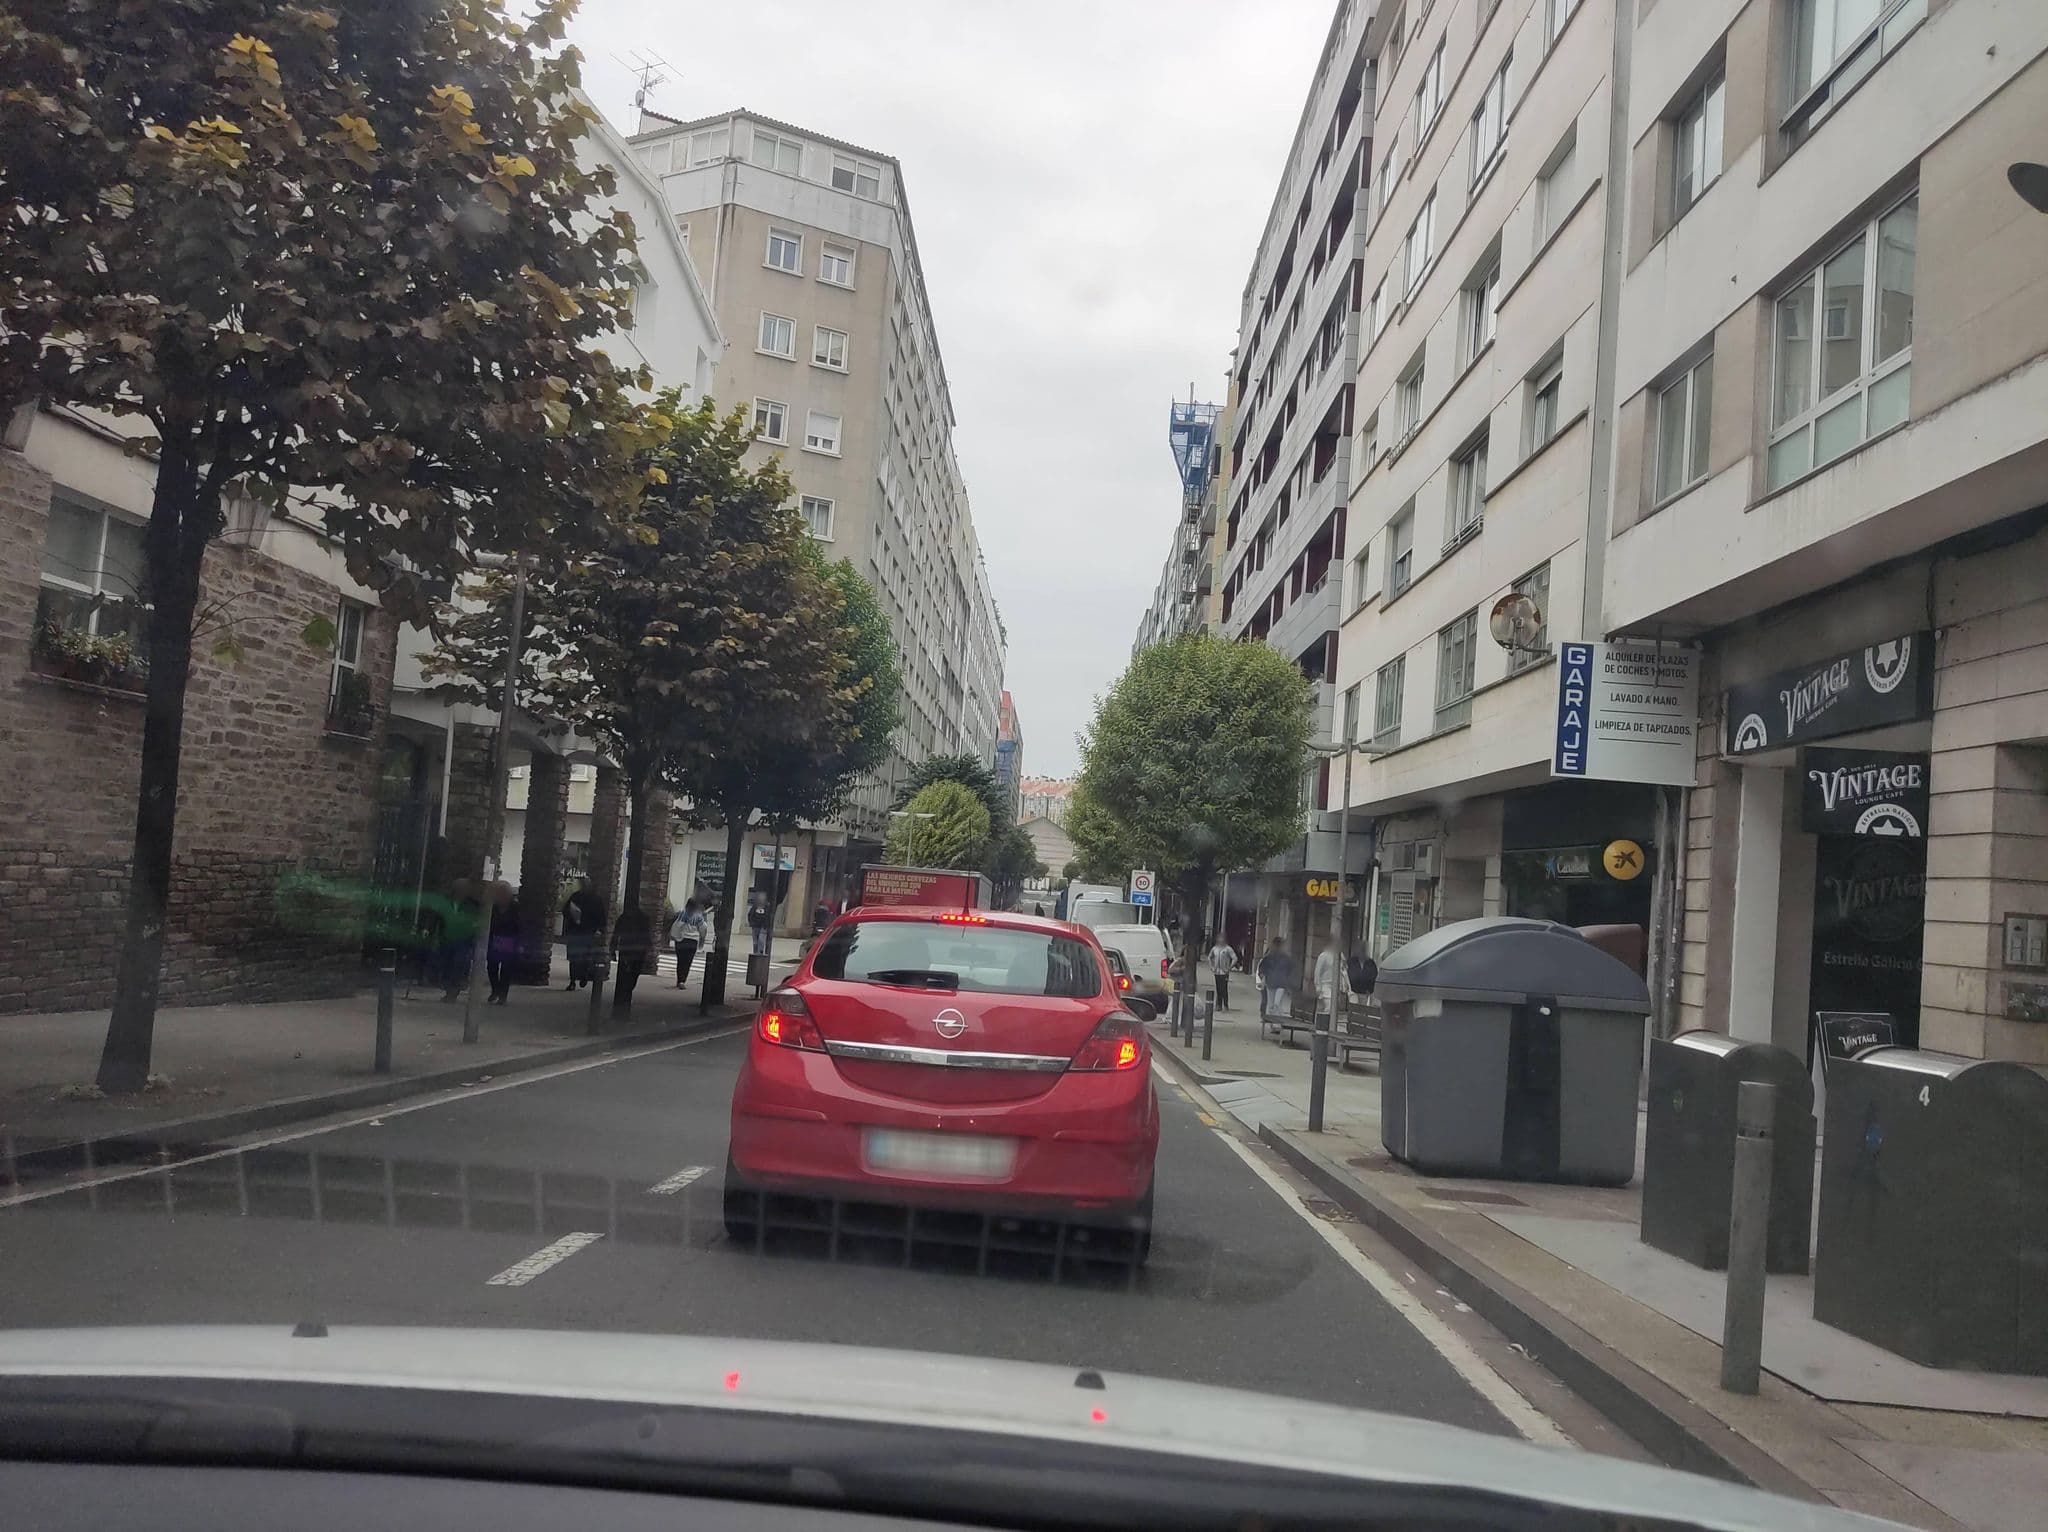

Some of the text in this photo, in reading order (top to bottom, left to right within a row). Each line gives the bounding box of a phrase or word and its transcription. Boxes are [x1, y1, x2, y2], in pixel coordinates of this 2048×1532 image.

[1605, 652, 1689, 666] ALQUILER DE PLAZAS
[1604, 664, 1615, 674] DE
[1617, 665, 1649, 676] COCHES
[1610, 693, 1643, 704] LAVADO
[1780, 658, 1849, 738] VINTAGE
[1562, 647, 1586, 770] GARAJE
[1594, 720, 1692, 736] LIMPIEZA DE TAPIZADOS.
[1808, 764, 1921, 812] VINTAGE
[1854, 794, 1883, 806] LOUNGE
[1861, 807, 1915, 829] ESTRELLA GALICIA
[1838, 1033, 1878, 1052] VINTAGE
[1919, 1085, 1930, 1107] 4
